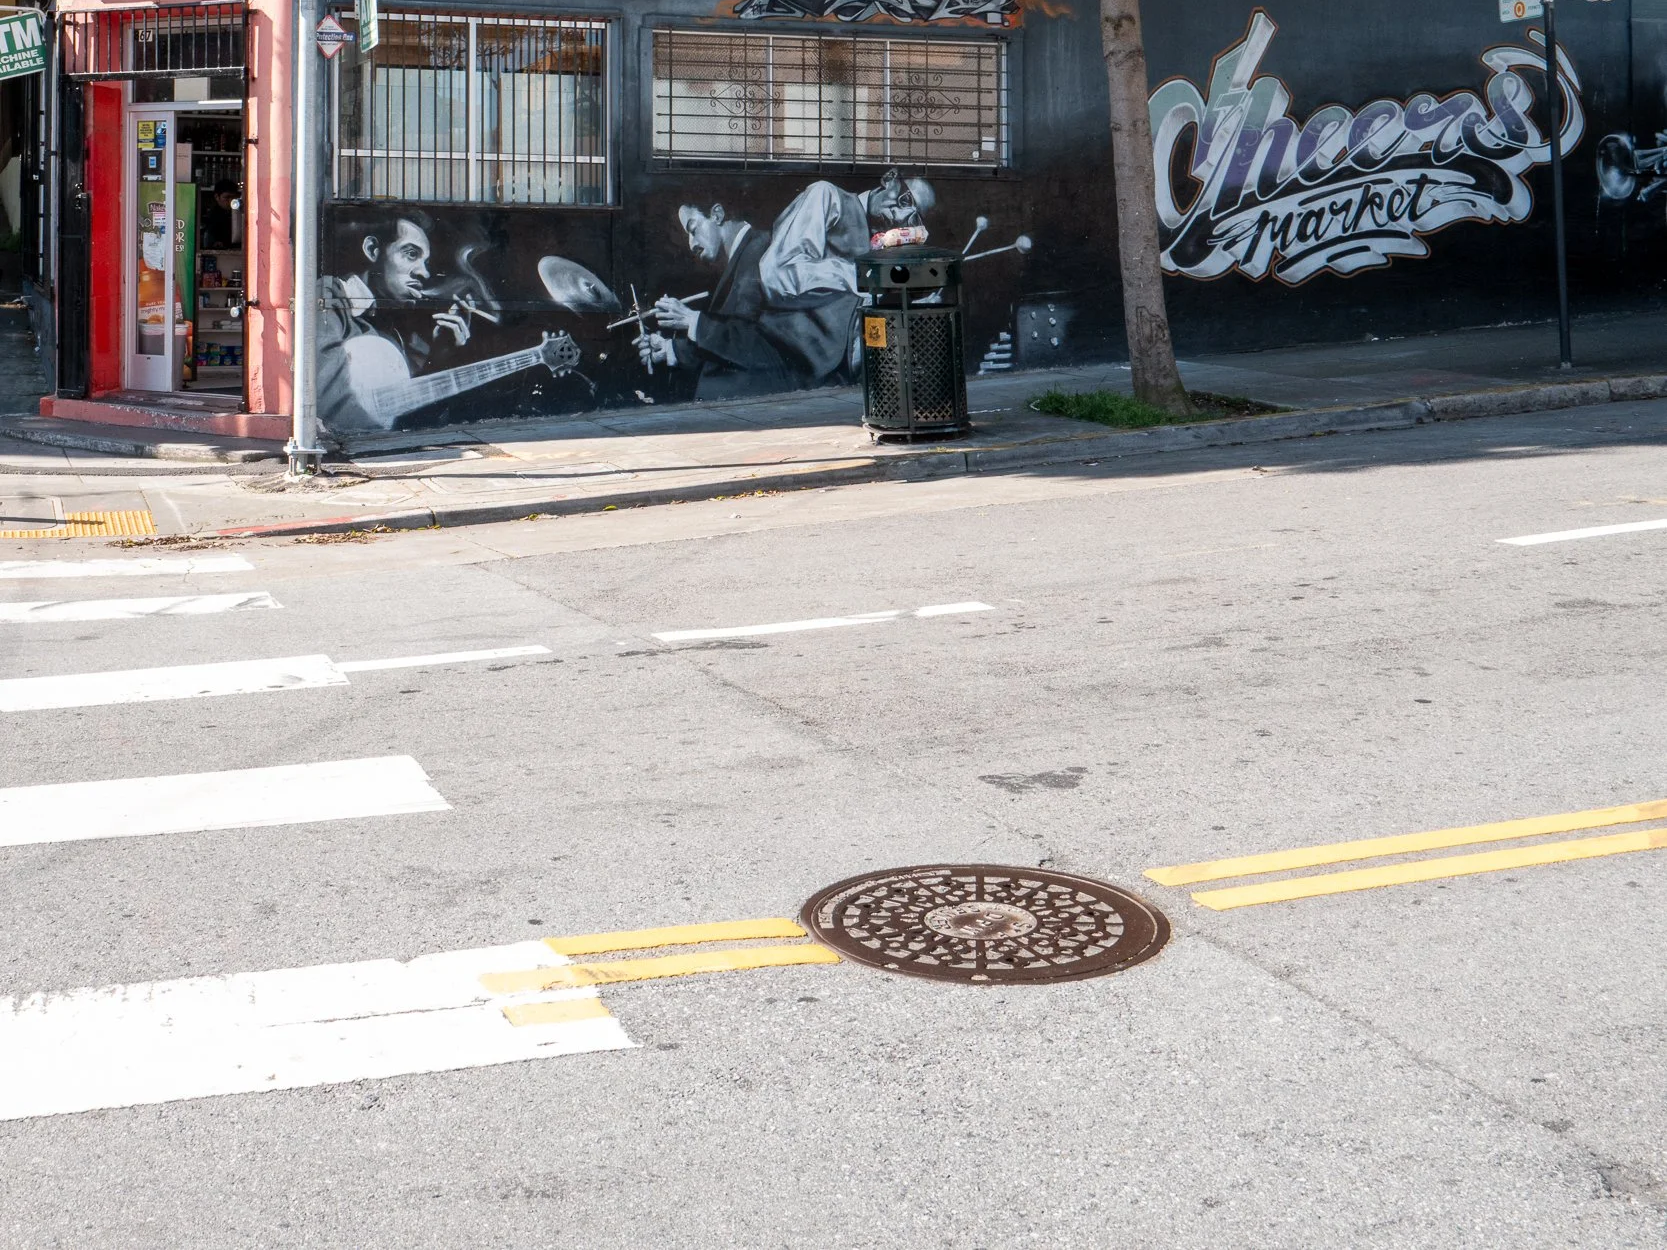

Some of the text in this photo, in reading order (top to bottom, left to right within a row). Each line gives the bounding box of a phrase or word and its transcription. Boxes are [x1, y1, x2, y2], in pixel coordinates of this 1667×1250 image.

[0, 17, 43, 54] TM
[0, 49, 39, 65] CHINE
[1148, 8, 1582, 272] Cheers
